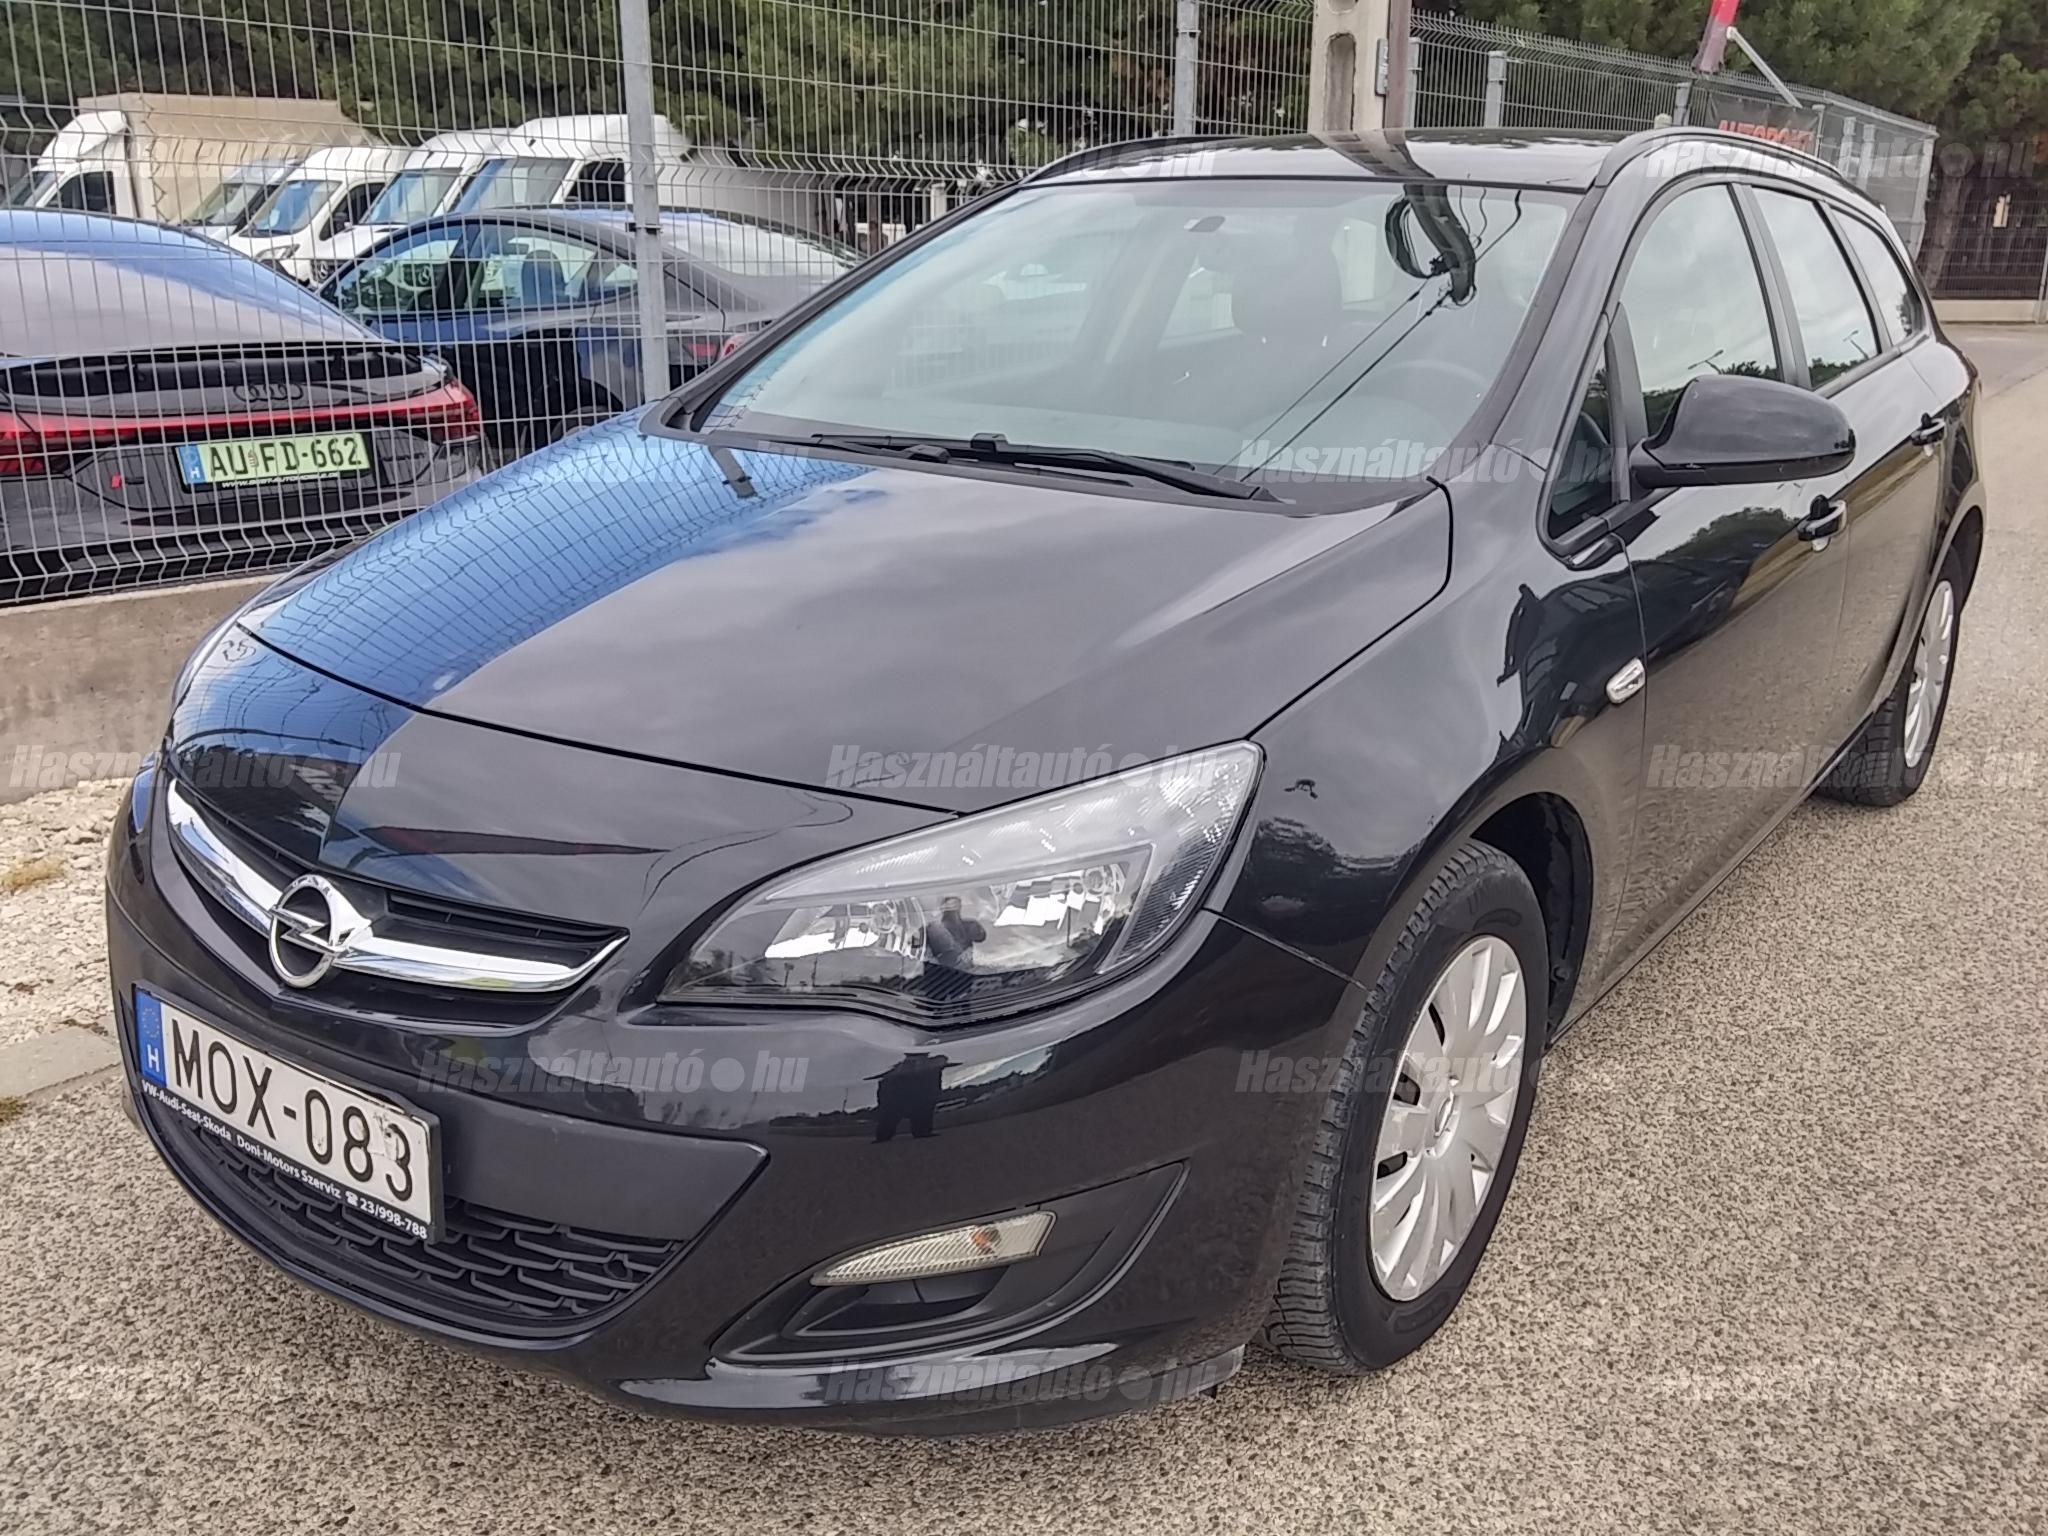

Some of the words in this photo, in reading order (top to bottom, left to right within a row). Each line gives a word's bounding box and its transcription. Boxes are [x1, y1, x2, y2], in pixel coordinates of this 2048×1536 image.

[147, 1043, 160, 1073] H
[171, 1018, 412, 1202] MOX-083
[236, 1134, 301, 1178] Doni-Motors
[300, 1170, 342, 1199] Szerviz
[359, 1197, 429, 1240] 23/998-788
